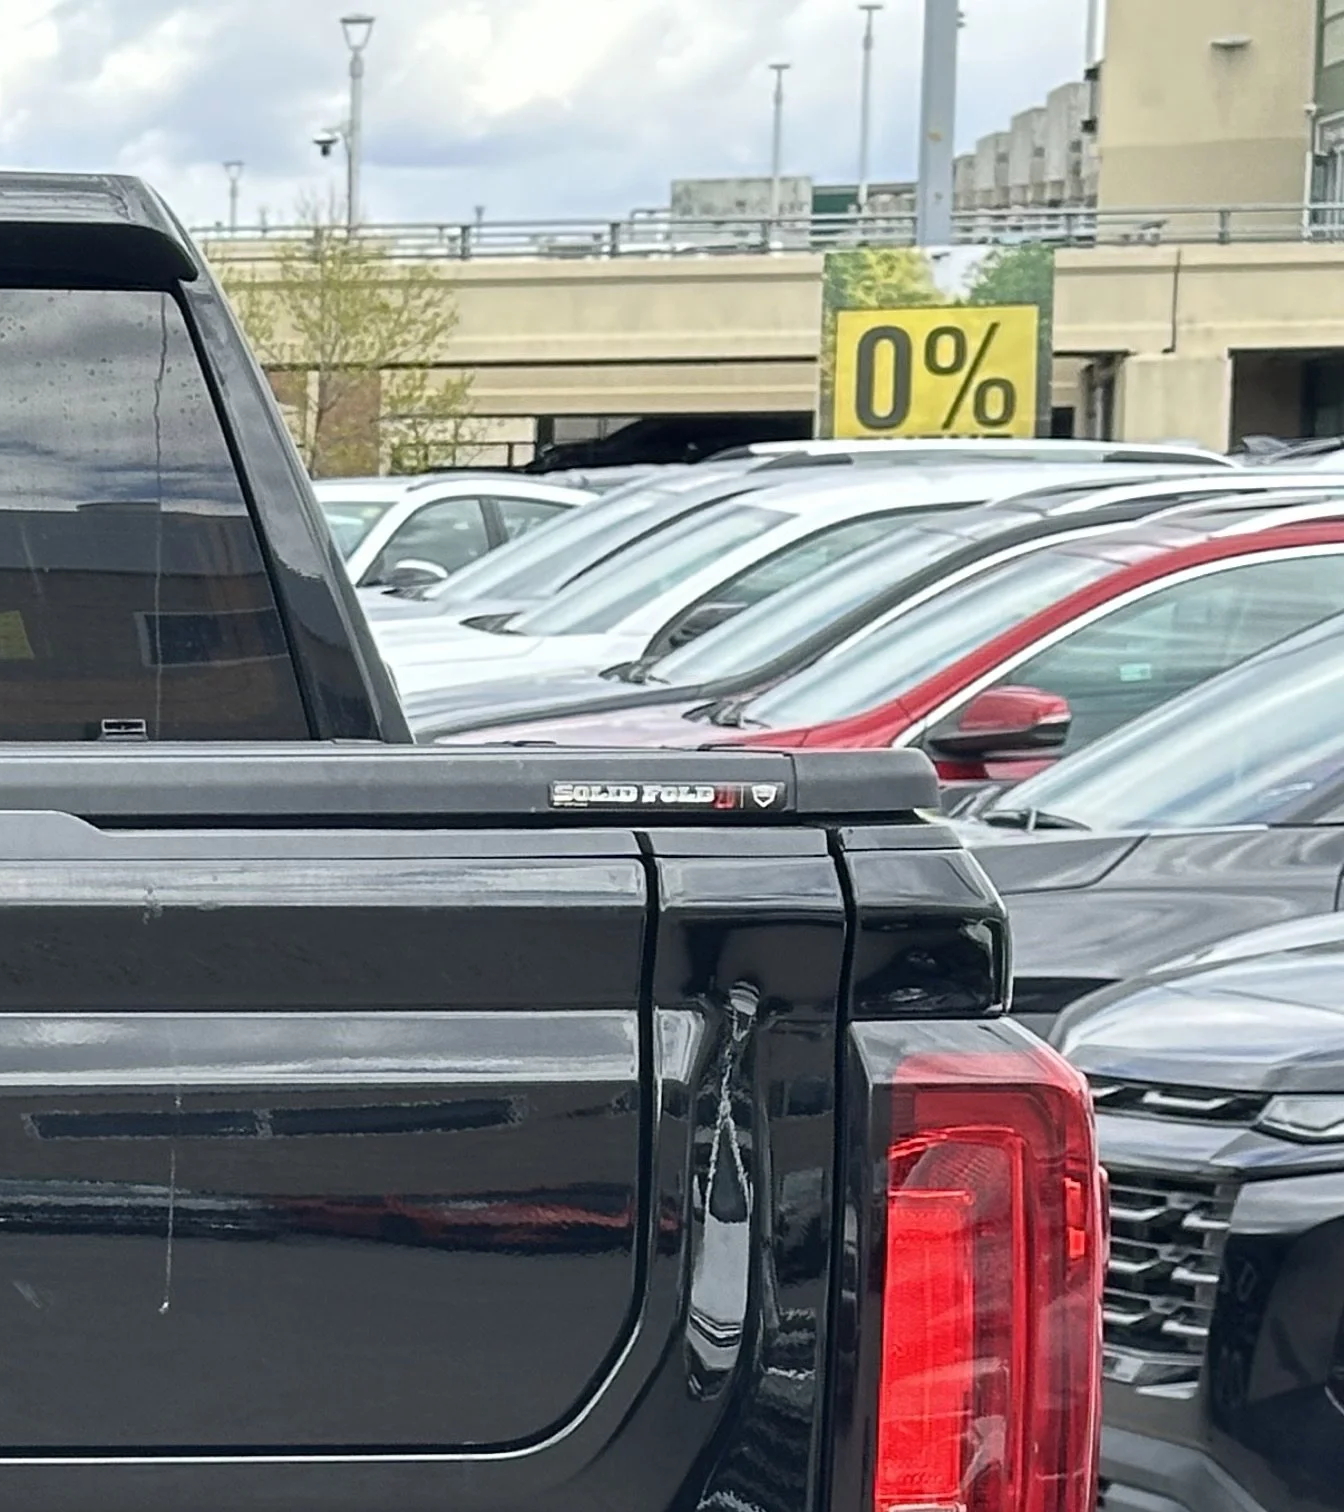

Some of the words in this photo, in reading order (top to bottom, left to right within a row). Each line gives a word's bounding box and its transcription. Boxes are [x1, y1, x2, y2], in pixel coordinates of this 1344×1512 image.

[855, 322, 1016, 431] 0%
[553, 784, 638, 802] SOLID
[641, 784, 714, 803] FOLD
